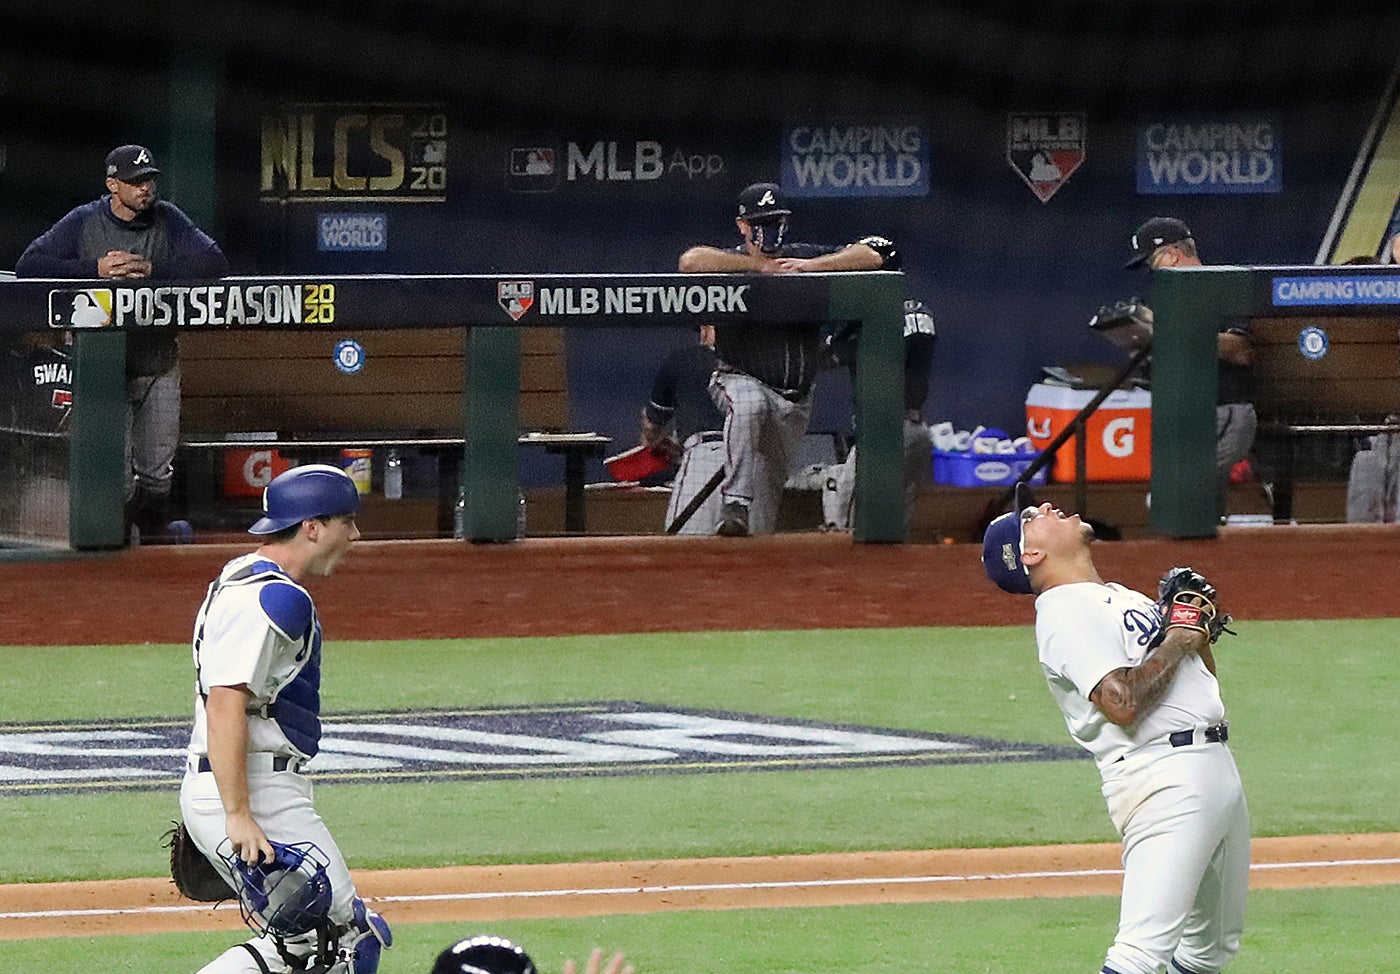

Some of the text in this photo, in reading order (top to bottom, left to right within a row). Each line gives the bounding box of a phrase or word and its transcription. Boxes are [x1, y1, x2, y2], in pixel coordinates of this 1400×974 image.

[790, 126, 921, 153] CAMPING
[1145, 123, 1273, 150] CAMPING
[261, 114, 404, 190] NLCS
[567, 141, 724, 181] MLB App
[410, 167, 446, 190] 20
[791, 154, 921, 187] WORLD
[1148, 151, 1273, 184] WORLD
[321, 217, 385, 232] CAMPING
[322, 231, 383, 247] WORLD
[304, 284, 335, 304] 20
[540, 285, 749, 315] MLB NETWORK
[1277, 279, 1355, 302] CAMPING
[116, 285, 302, 327] POSTSEASON
[304, 303, 335, 324] 20
[1102, 417, 1135, 458] G
[243, 450, 273, 488] G
